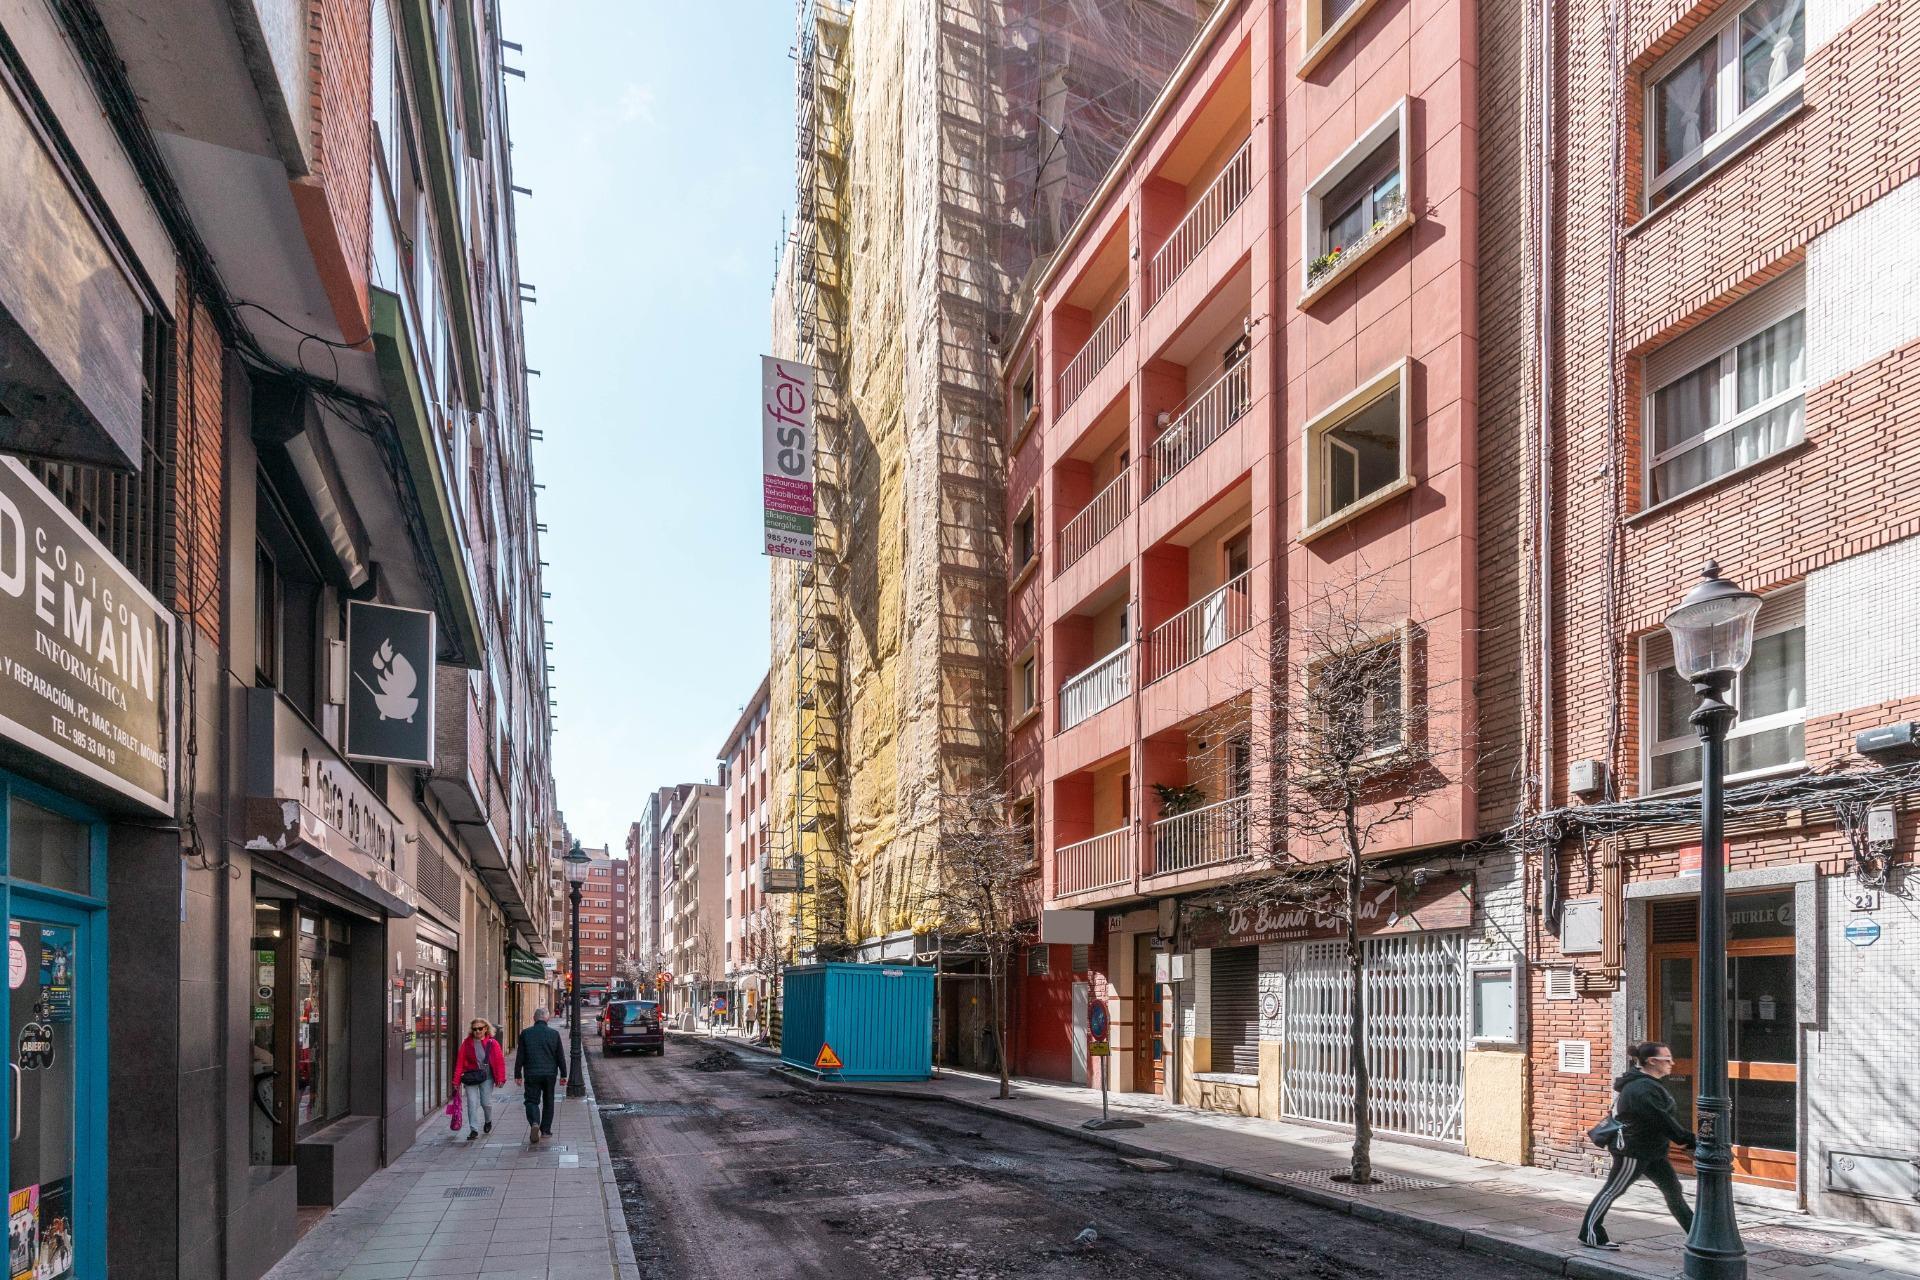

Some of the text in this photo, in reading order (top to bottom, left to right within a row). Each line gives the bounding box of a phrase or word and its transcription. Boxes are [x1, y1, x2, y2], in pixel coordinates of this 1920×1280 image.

[767, 363, 806, 477] esfer
[765, 476, 808, 490] Restauración
[765, 488, 812, 502] Rehabilitación
[765, 499, 811, 513] Conservación
[765, 510, 797, 523] Eficiencia
[766, 519, 802, 531] energética
[767, 533, 812, 547] 985 299 619
[767, 543, 813, 558] esfer.es
[36, 527, 128, 626] CODIGO
[36, 630, 127, 712] INFORMÁTICA
[4, 656, 12, 676] Y
[14, 662, 77, 717] REPARACIÓN,
[77, 703, 91, 726] PC,
[92, 712, 112, 739] MAC,
[140, 742, 167, 770] MÓVILES
[72, 728, 87, 748] 985
[87, 736, 97, 754] 33
[97, 742, 106, 760] 04
[107, 748, 116, 765] 19
[1855, 894, 1873, 908] 23
[1228, 907, 1249, 934] De
[1254, 903, 1308, 933] Buena
[1268, 929, 1309, 940] RESTAURANTE
[22, 1041, 51, 1052] ABIERTO
